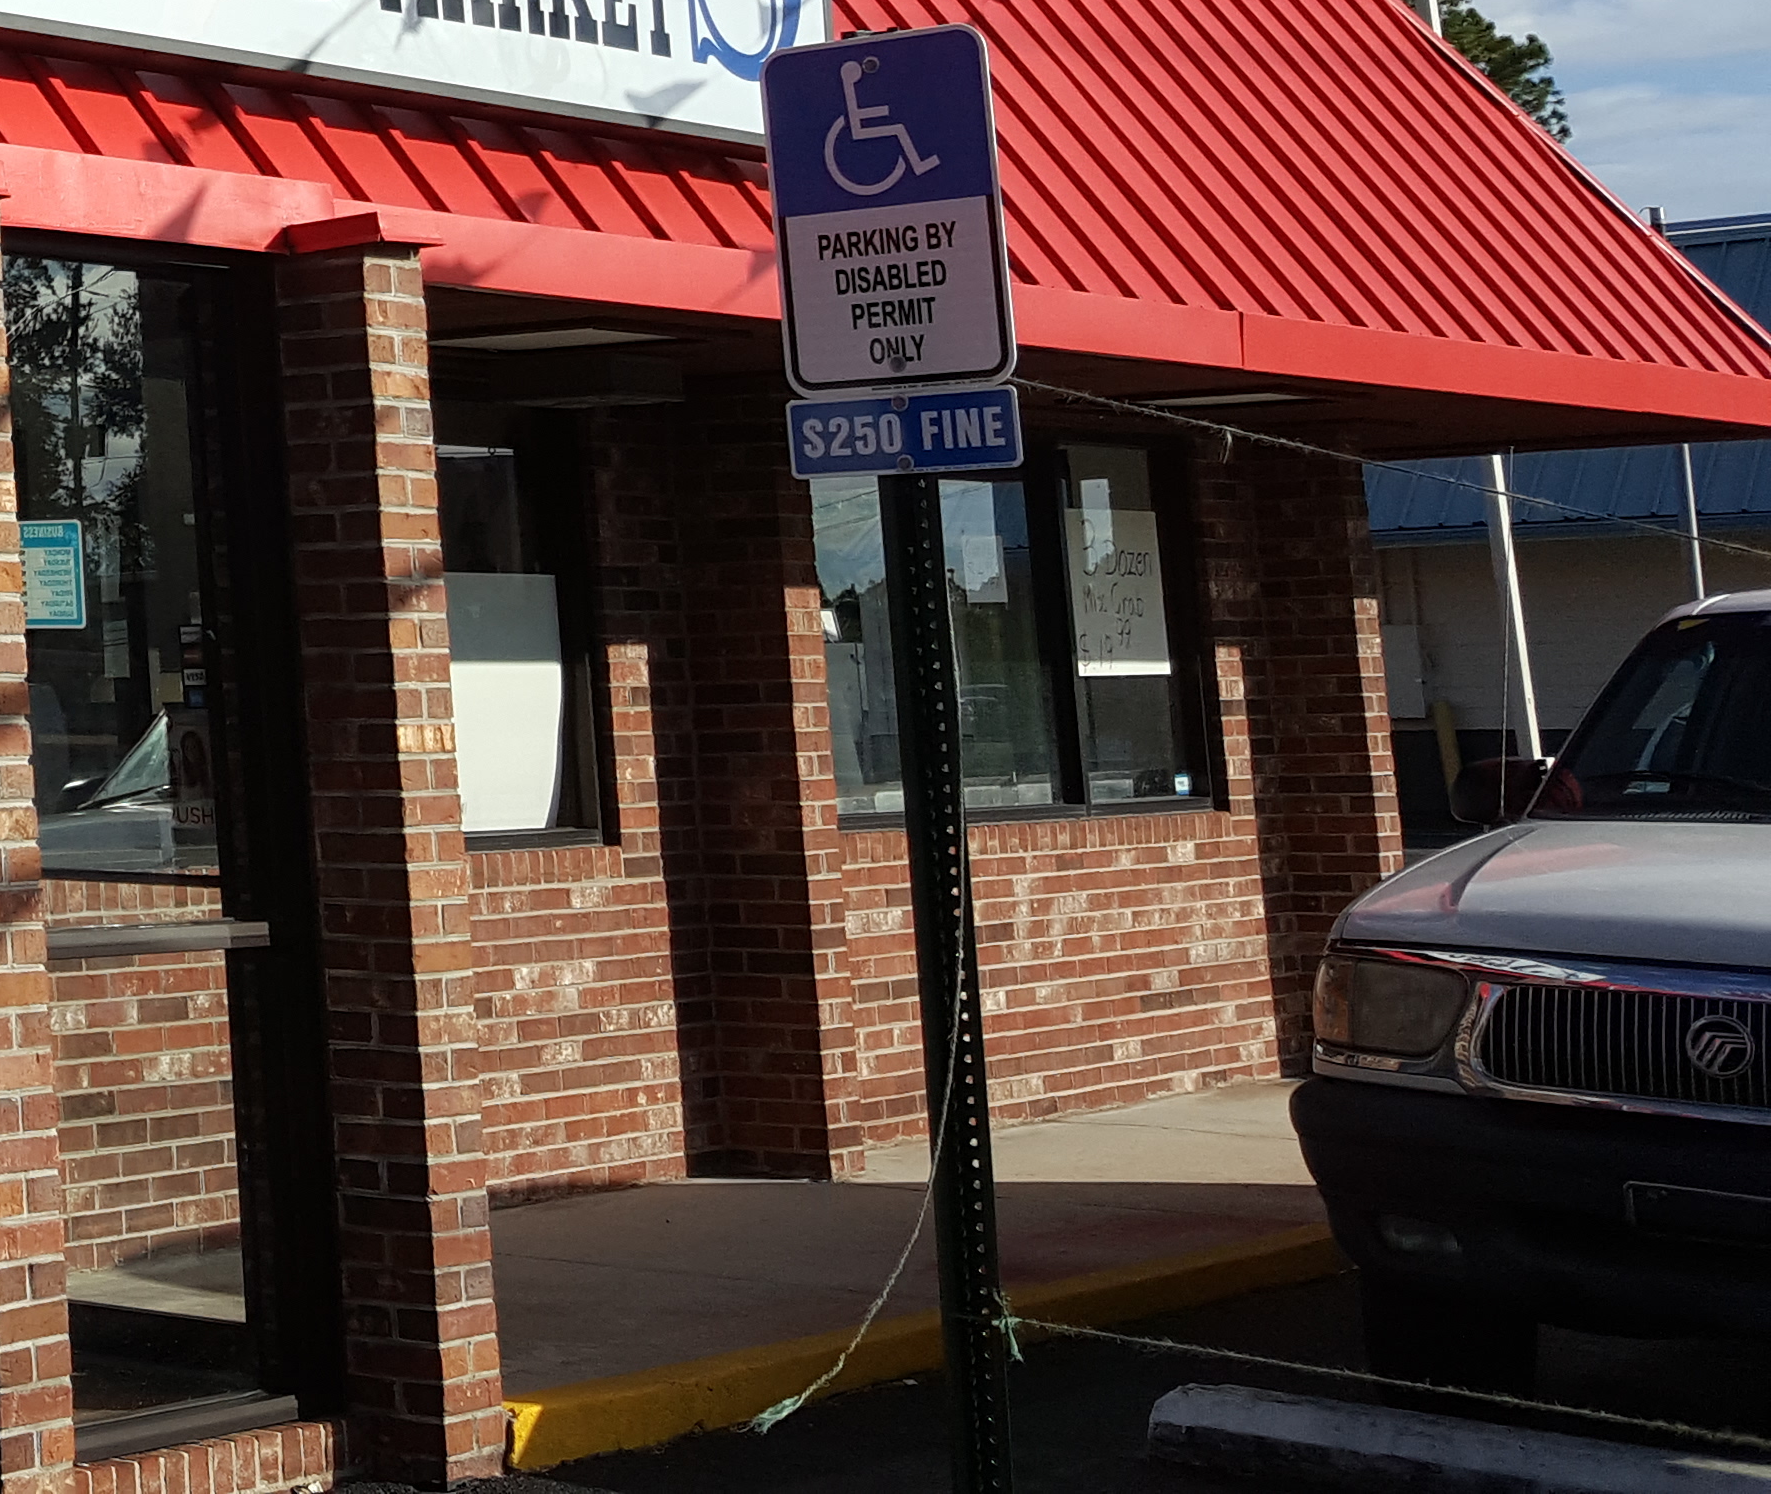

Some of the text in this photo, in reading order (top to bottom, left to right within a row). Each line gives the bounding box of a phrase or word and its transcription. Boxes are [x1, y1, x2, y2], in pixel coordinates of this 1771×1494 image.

[817, 220, 957, 260] PARKING BY
[835, 259, 947, 296] DISABLED
[851, 297, 936, 330] PERMIT
[869, 334, 925, 365] ONLY
[802, 406, 1006, 459] $250 FINE
[1104, 539, 1152, 576] Dozen
[1110, 581, 1146, 617] Crab
[172, 807, 215, 824] USH
